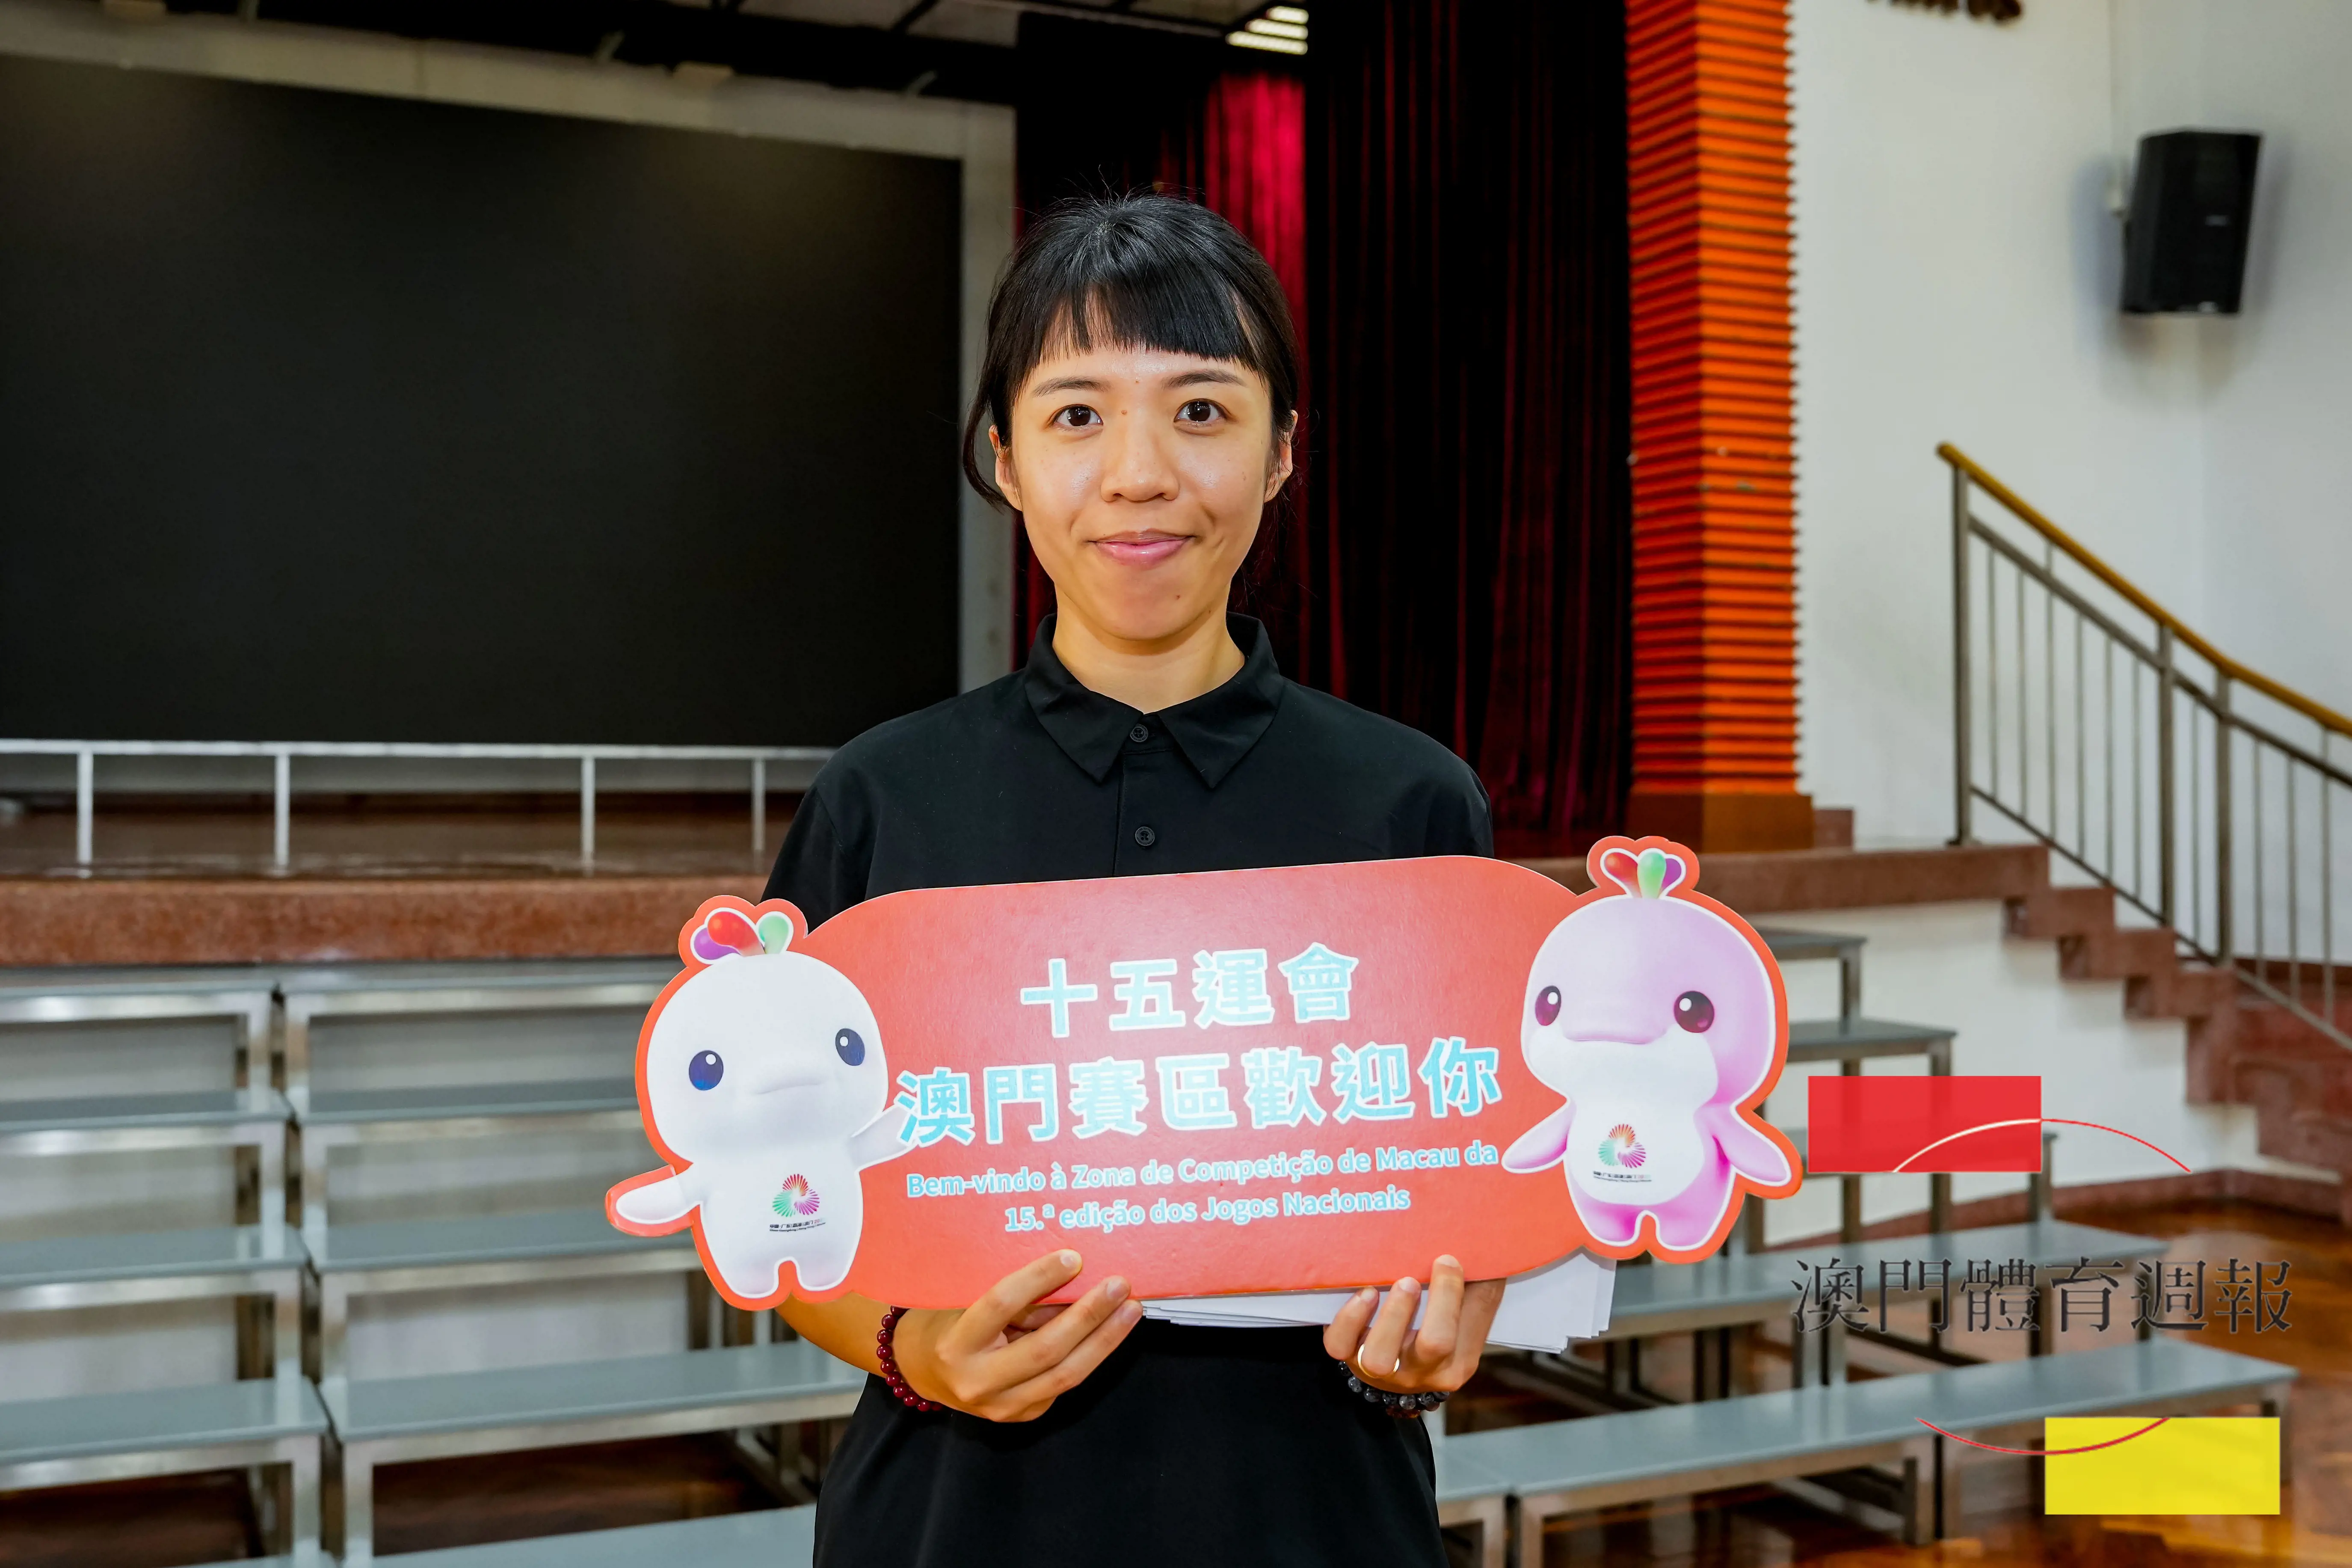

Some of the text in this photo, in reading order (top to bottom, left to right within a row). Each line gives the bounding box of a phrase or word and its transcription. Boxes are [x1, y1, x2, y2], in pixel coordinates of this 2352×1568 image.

[1021, 943, 1358, 1037] 十五運會
[895, 1037, 1502, 1146] 澳門賽區歡迎你
[906, 1140, 1498, 1197] Bem-vindo à Zona de Competição de Macau da
[1059, 1200, 1145, 1233] edição
[1149, 1197, 1197, 1224] dos
[1201, 1197, 1278, 1225] Jogos
[1283, 1184, 1411, 1216] Nacionais
